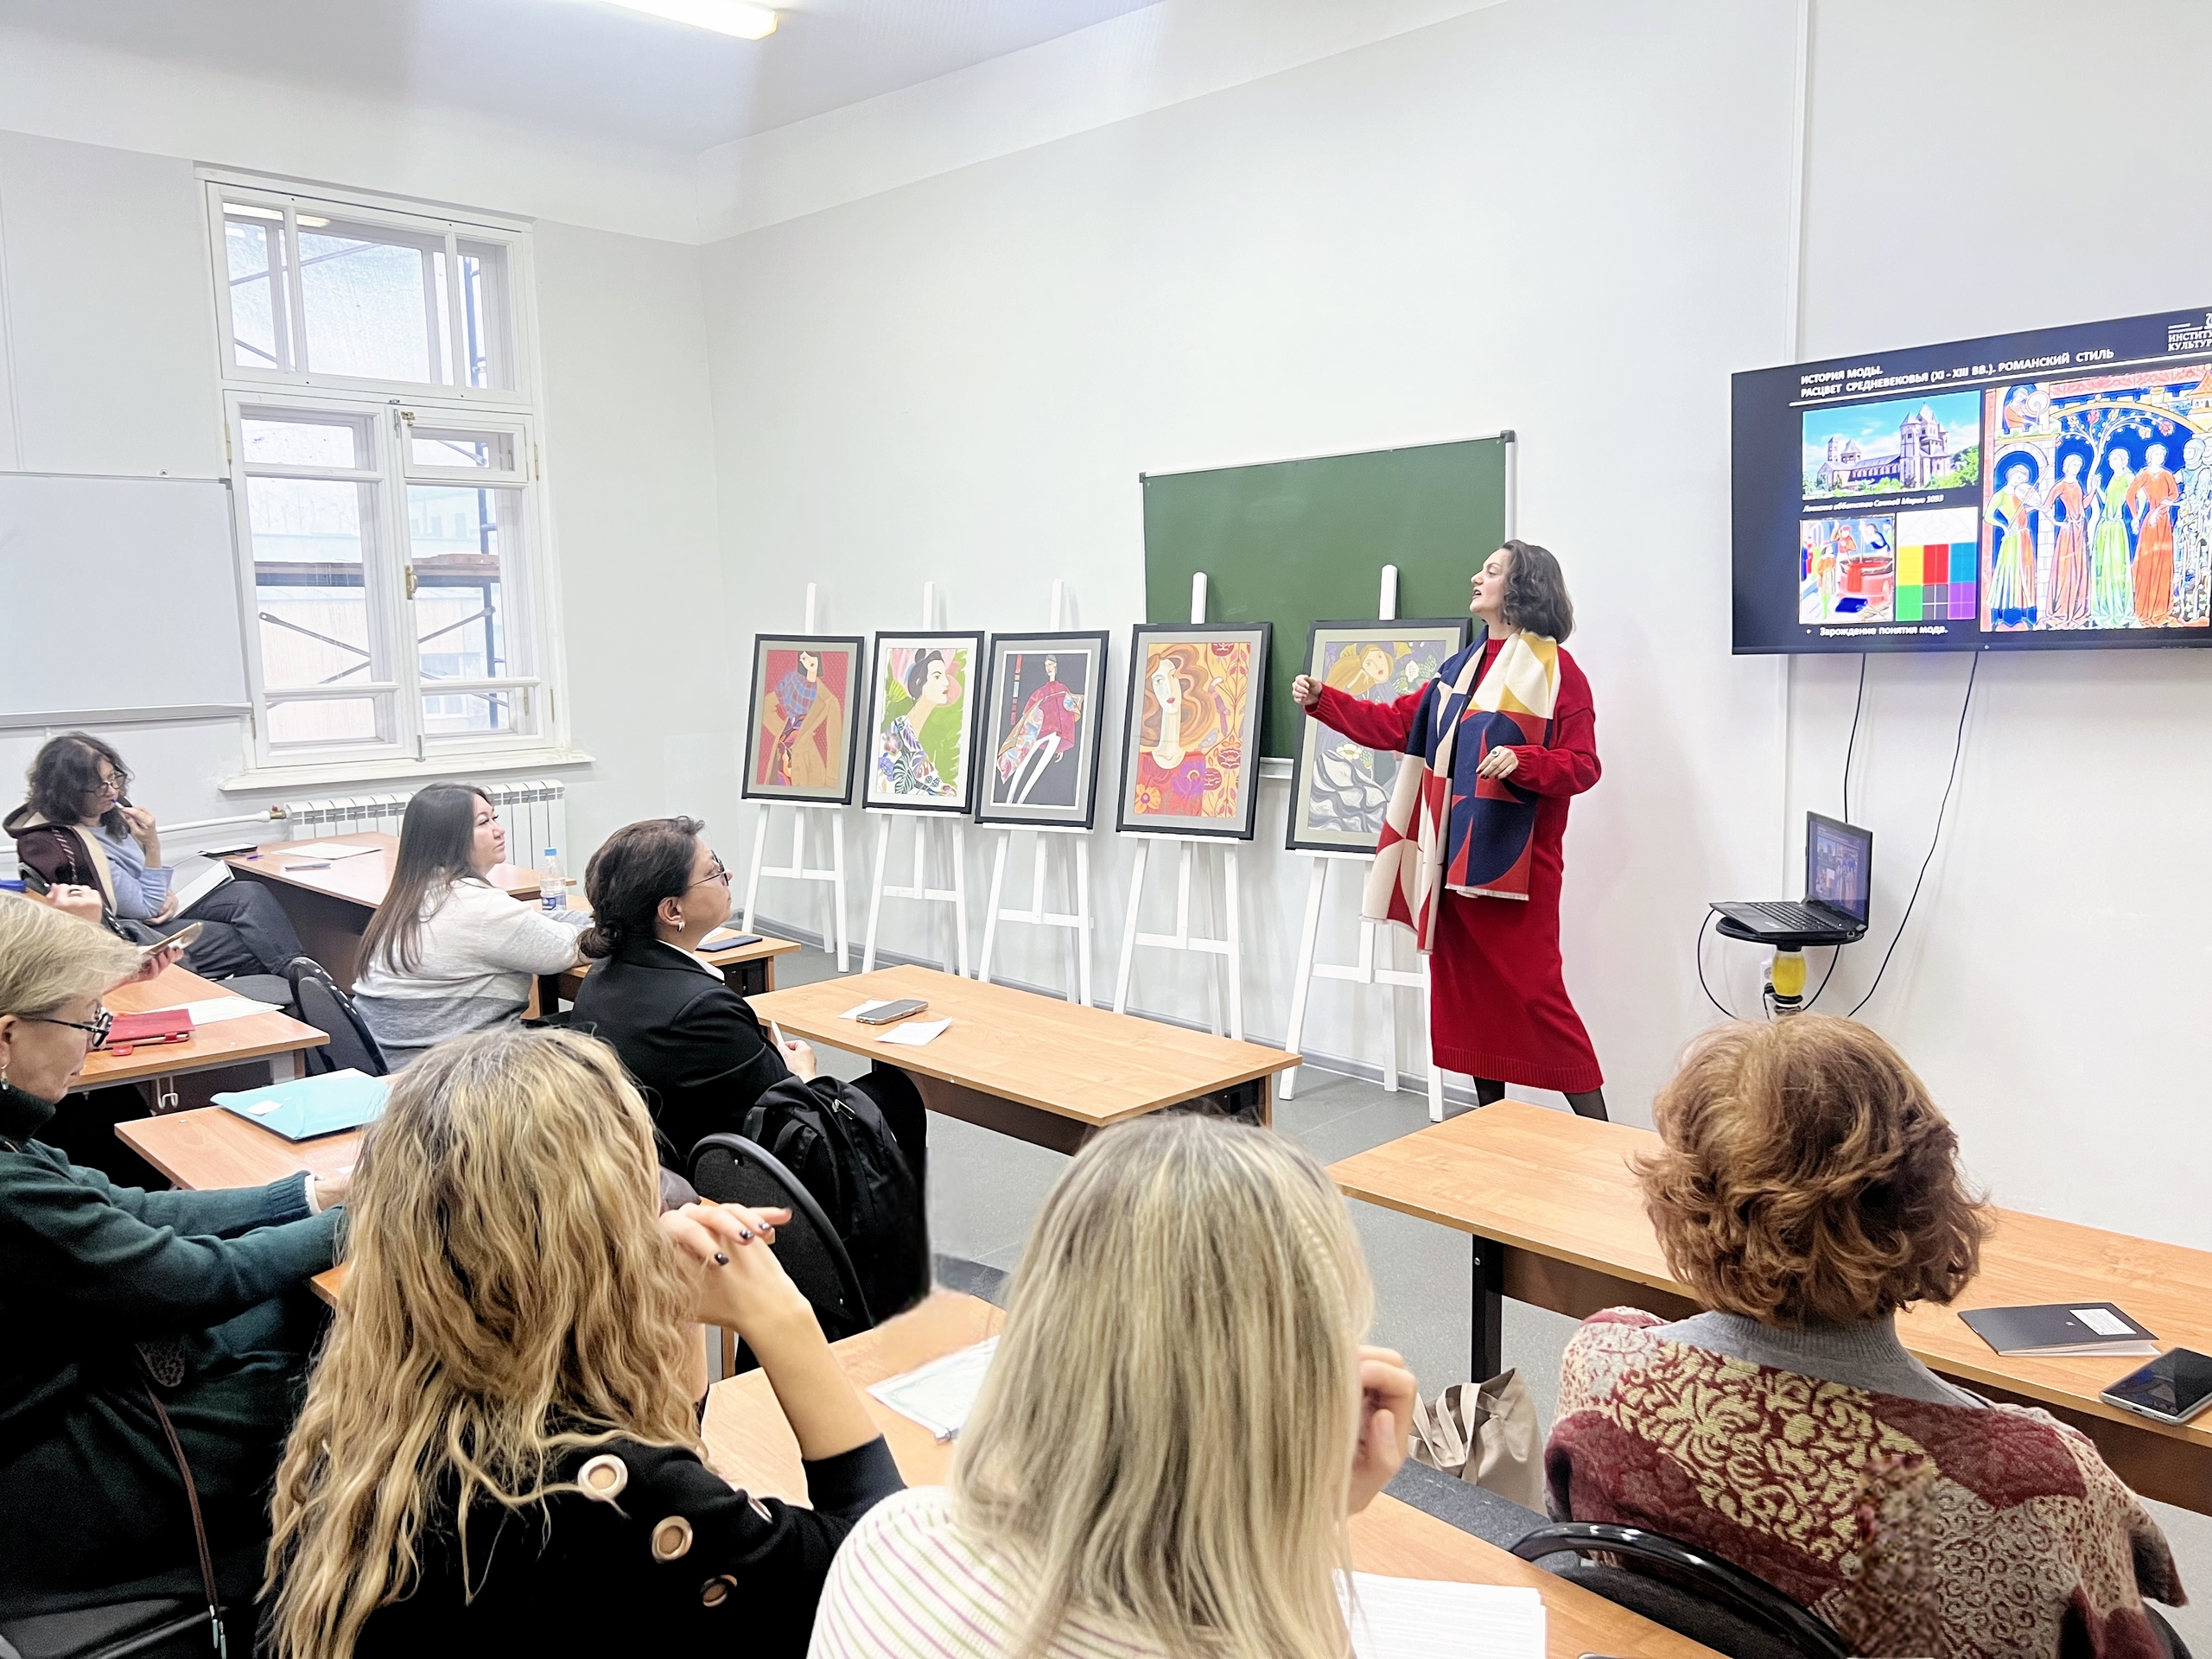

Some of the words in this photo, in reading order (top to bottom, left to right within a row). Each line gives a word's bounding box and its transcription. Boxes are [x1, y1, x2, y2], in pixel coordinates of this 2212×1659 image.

[1801, 384, 1843, 398] РАСЦВЕТ
[1846, 372, 1929, 392] СРЕДНЕВЕКОВЬЯ
[1998, 352, 2070, 372] РОМАНСКИЙ
[2075, 348, 2114, 363] СТИЛЬ
[1801, 370, 1845, 385] ИСТОРИЯ
[1847, 365, 1884, 379] МОДЫ.
[1819, 626, 1877, 639] Зарождение
[1878, 626, 1917, 635] понятия
